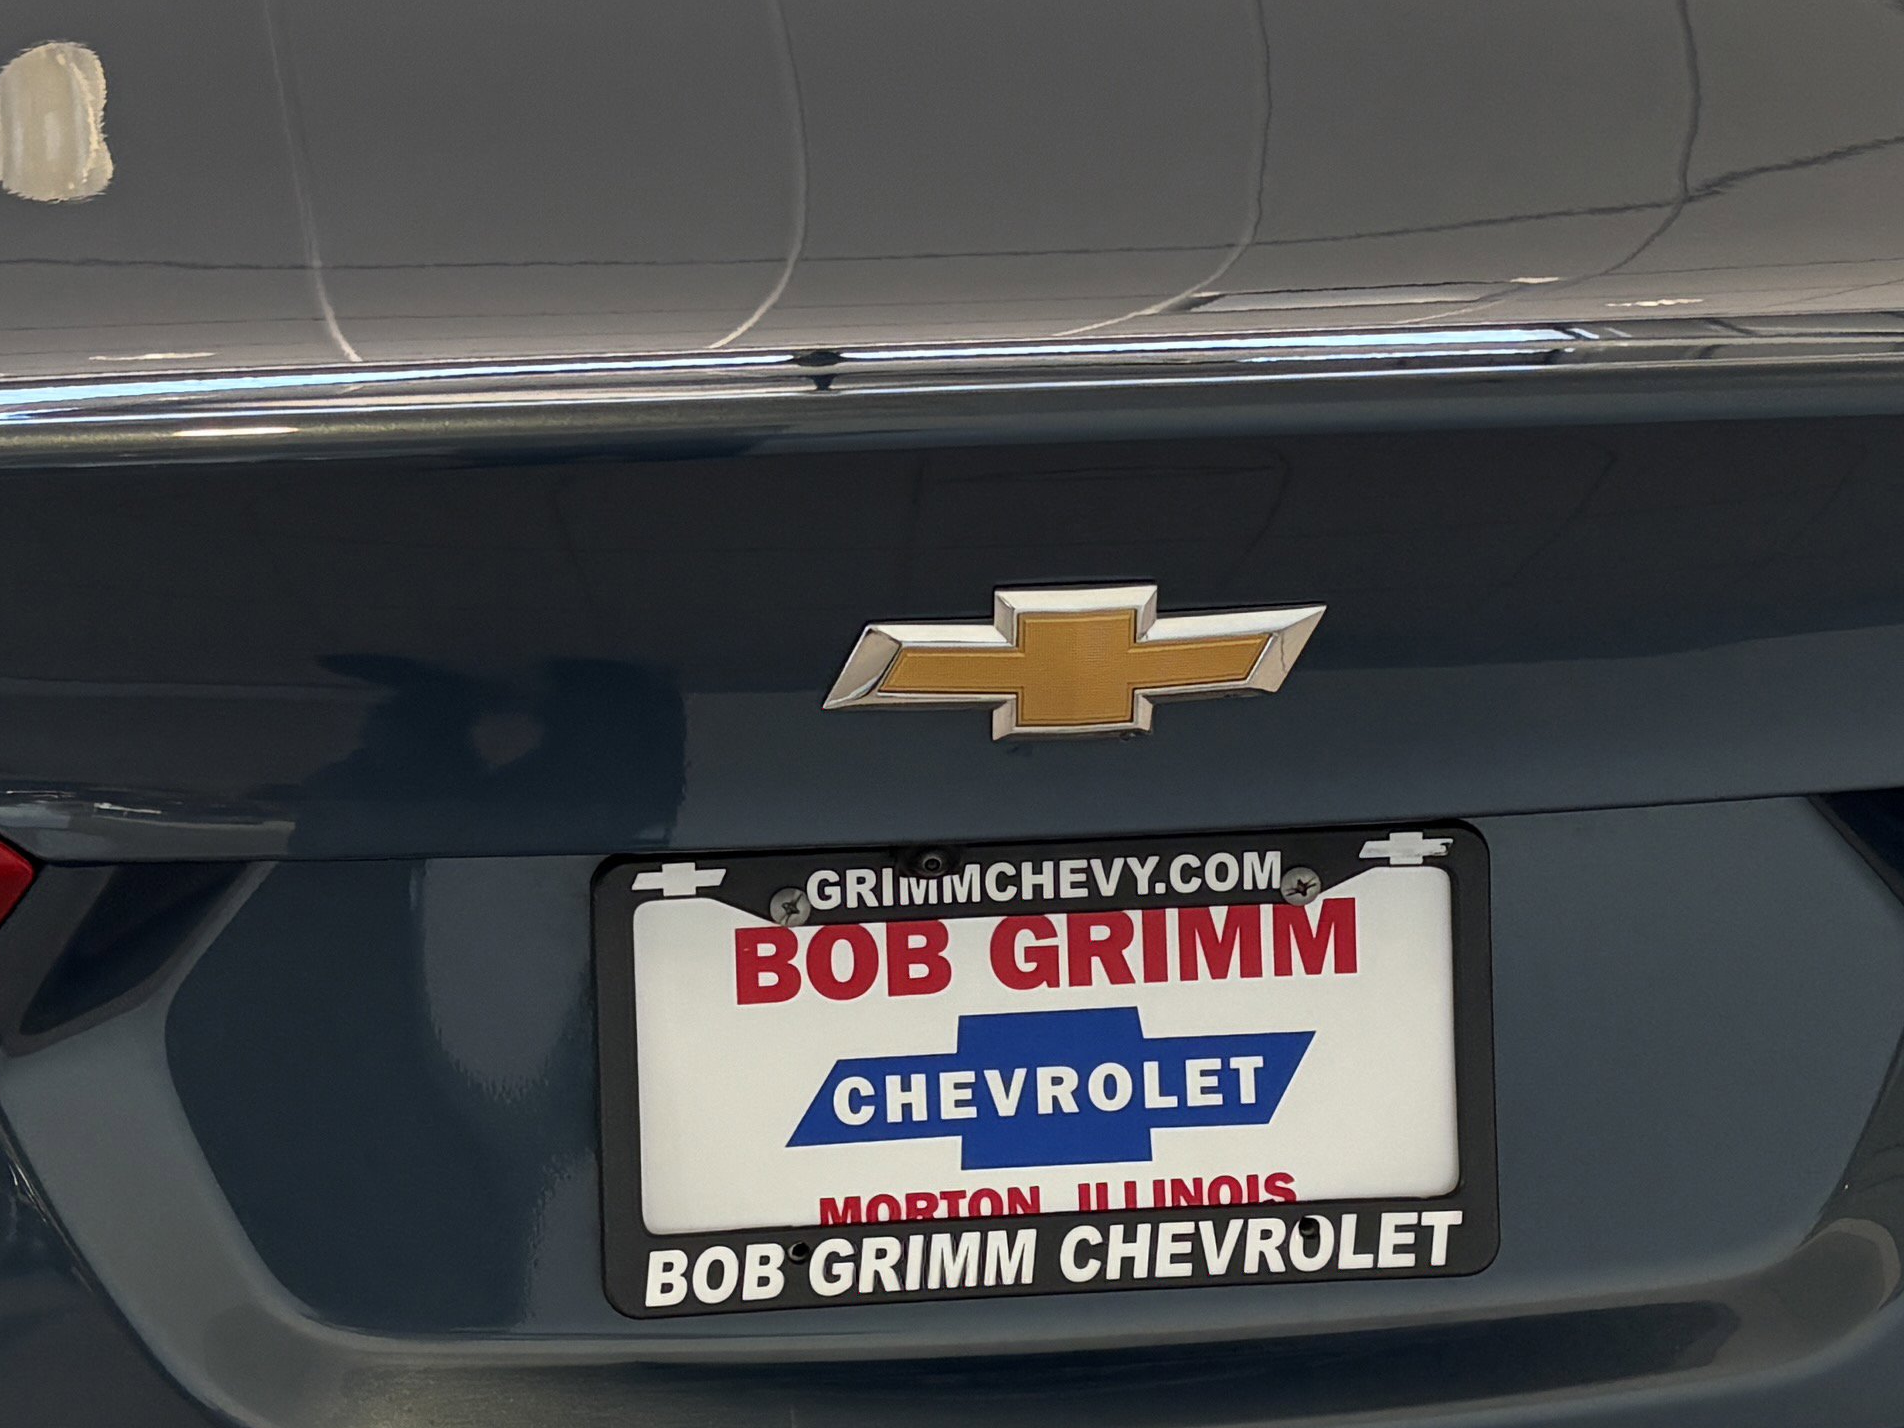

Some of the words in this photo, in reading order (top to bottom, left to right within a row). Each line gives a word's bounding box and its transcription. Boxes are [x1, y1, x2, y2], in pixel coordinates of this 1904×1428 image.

[806, 851, 1282, 911] GRIMMCHEVY.COM
[734, 919, 952, 1006] BOB
[989, 897, 1358, 991] GRIMM
[832, 1054, 1264, 1127] CHEVROLET
[645, 1242, 786, 1308] BOB
[808, 1228, 1038, 1298] GRIMM
[1059, 1210, 1464, 1283] CHEVROLET
